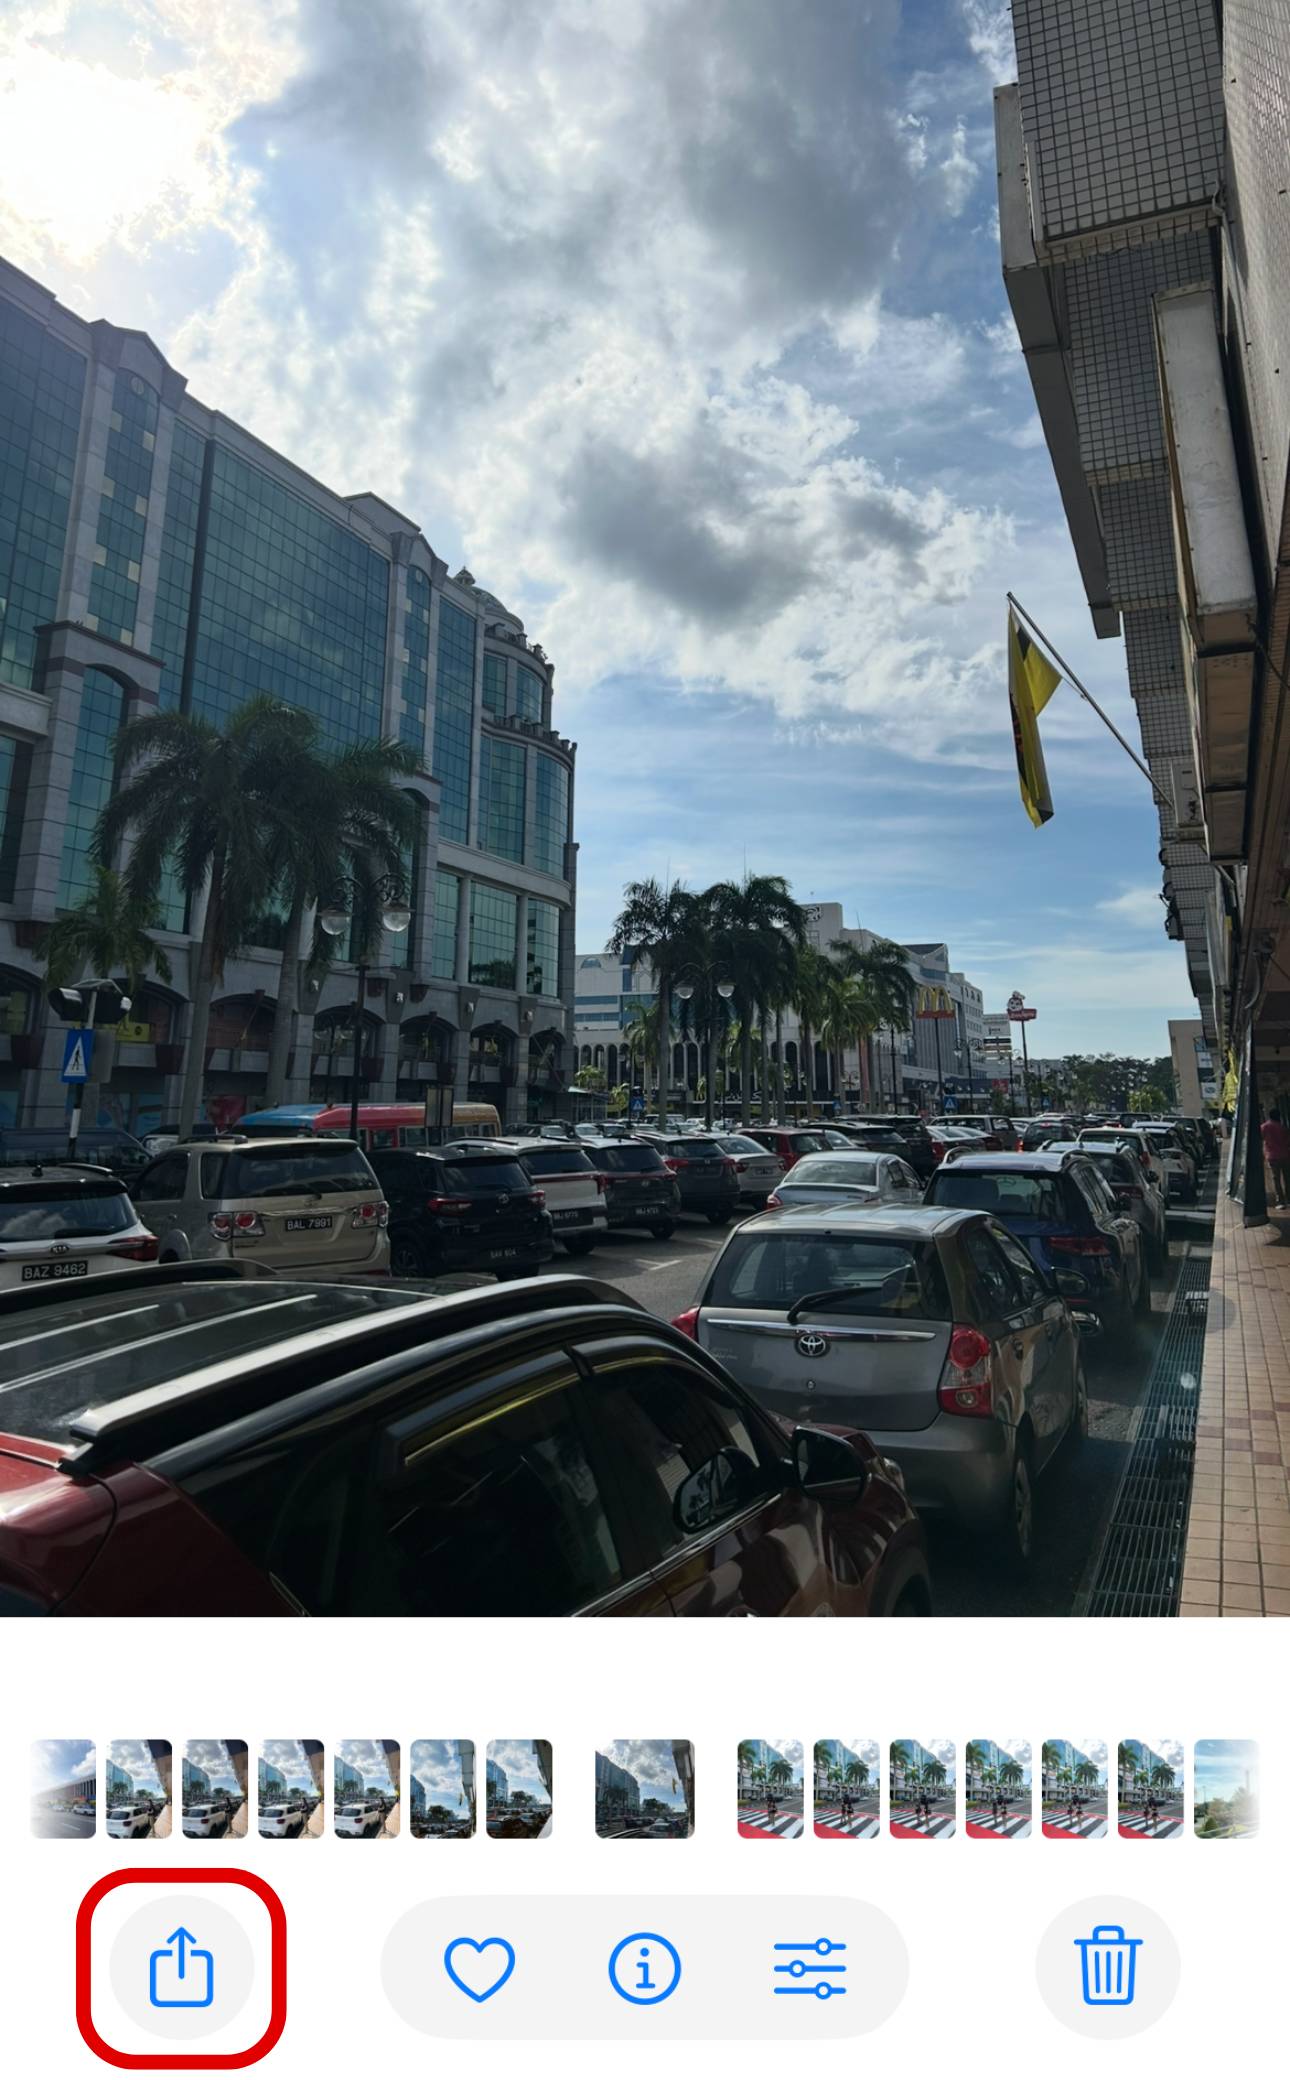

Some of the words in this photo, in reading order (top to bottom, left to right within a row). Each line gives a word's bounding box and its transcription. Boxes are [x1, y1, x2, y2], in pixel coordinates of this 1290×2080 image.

[287, 1220, 305, 1230] BAL
[24, 1266, 49, 1279] BAZ
[54, 1263, 86, 1276] 9462
